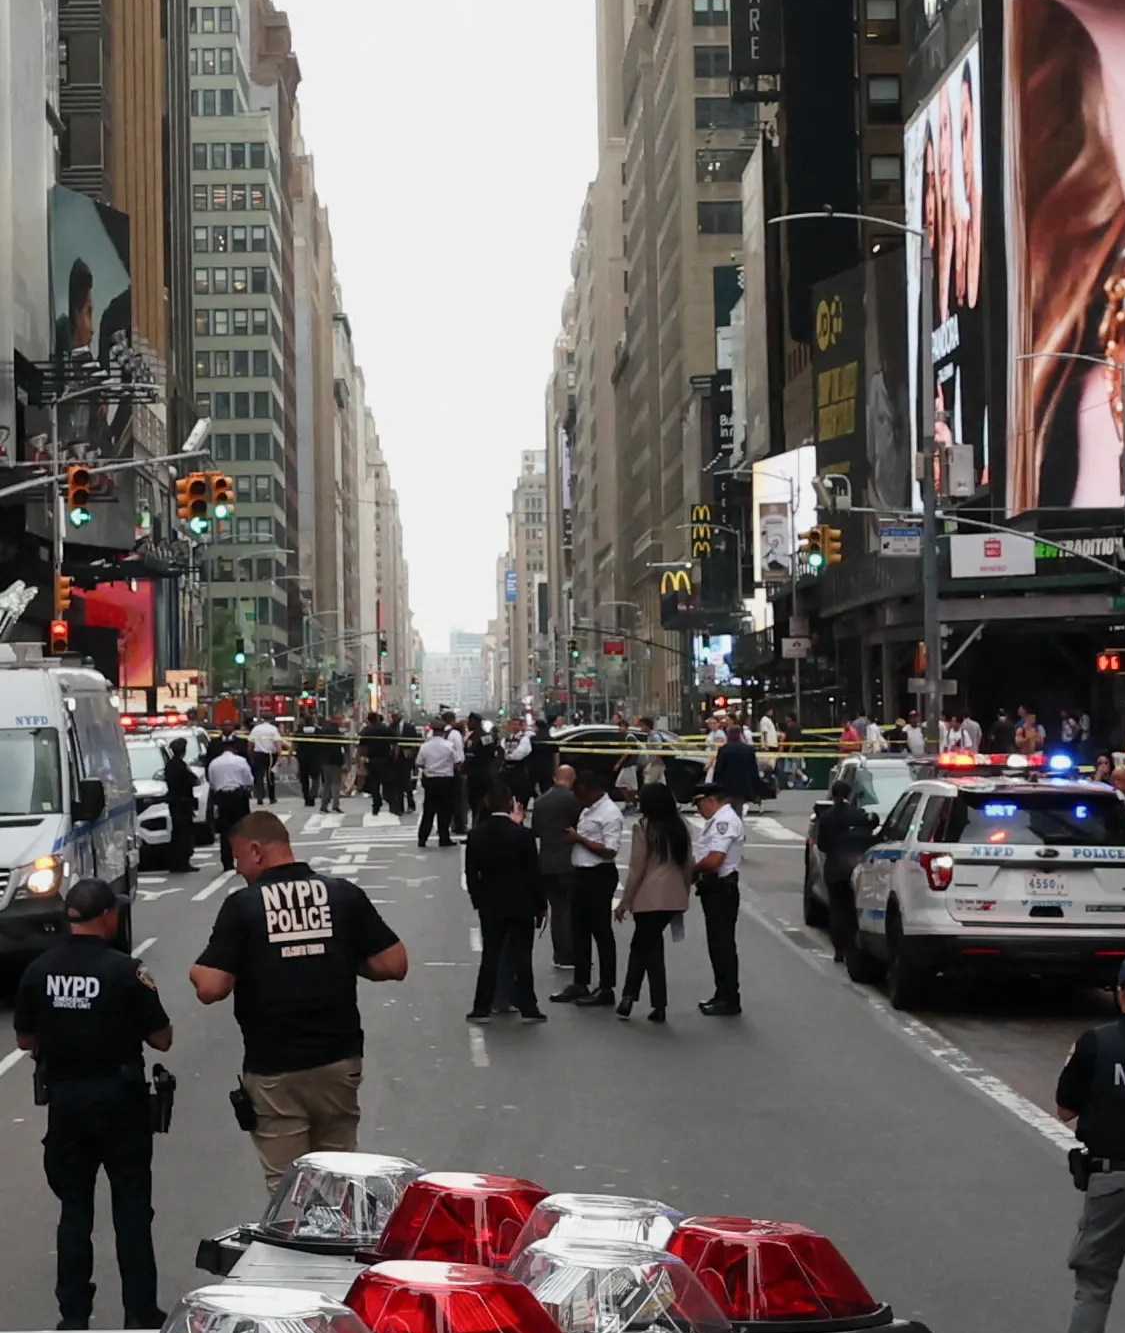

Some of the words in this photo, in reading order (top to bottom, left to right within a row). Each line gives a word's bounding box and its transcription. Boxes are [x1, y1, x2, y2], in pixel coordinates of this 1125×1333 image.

[15, 715, 49, 725] NYPD
[971, 846, 1015, 858] NYPD
[260, 879, 328, 911] NYPD
[265, 905, 333, 934] POLICE
[46, 974, 100, 998] NYPD
